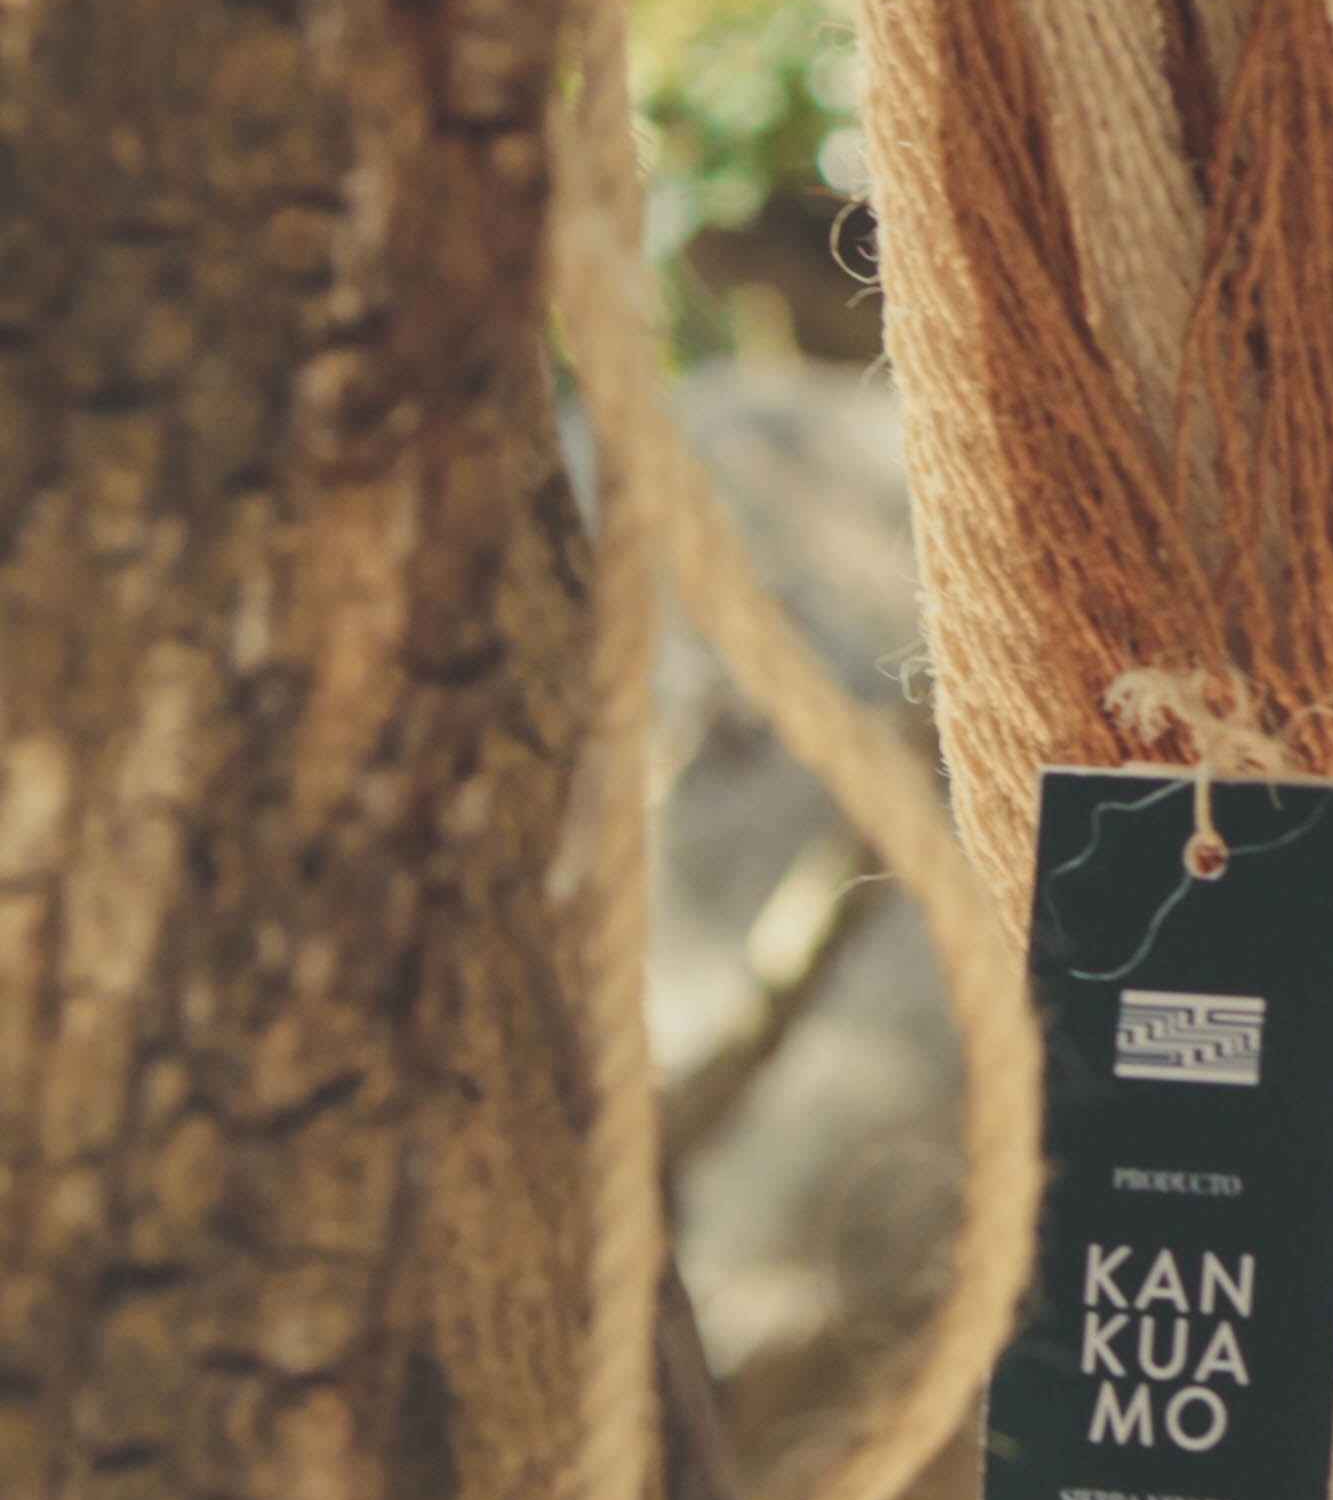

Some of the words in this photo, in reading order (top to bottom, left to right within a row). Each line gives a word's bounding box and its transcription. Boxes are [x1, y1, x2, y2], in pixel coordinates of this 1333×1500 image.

[1113, 1167, 1242, 1197] PRODUCTO
[1085, 1243, 1255, 1318] KAN
[1081, 1311, 1249, 1386] KUA
[1088, 1379, 1227, 1451] MO
